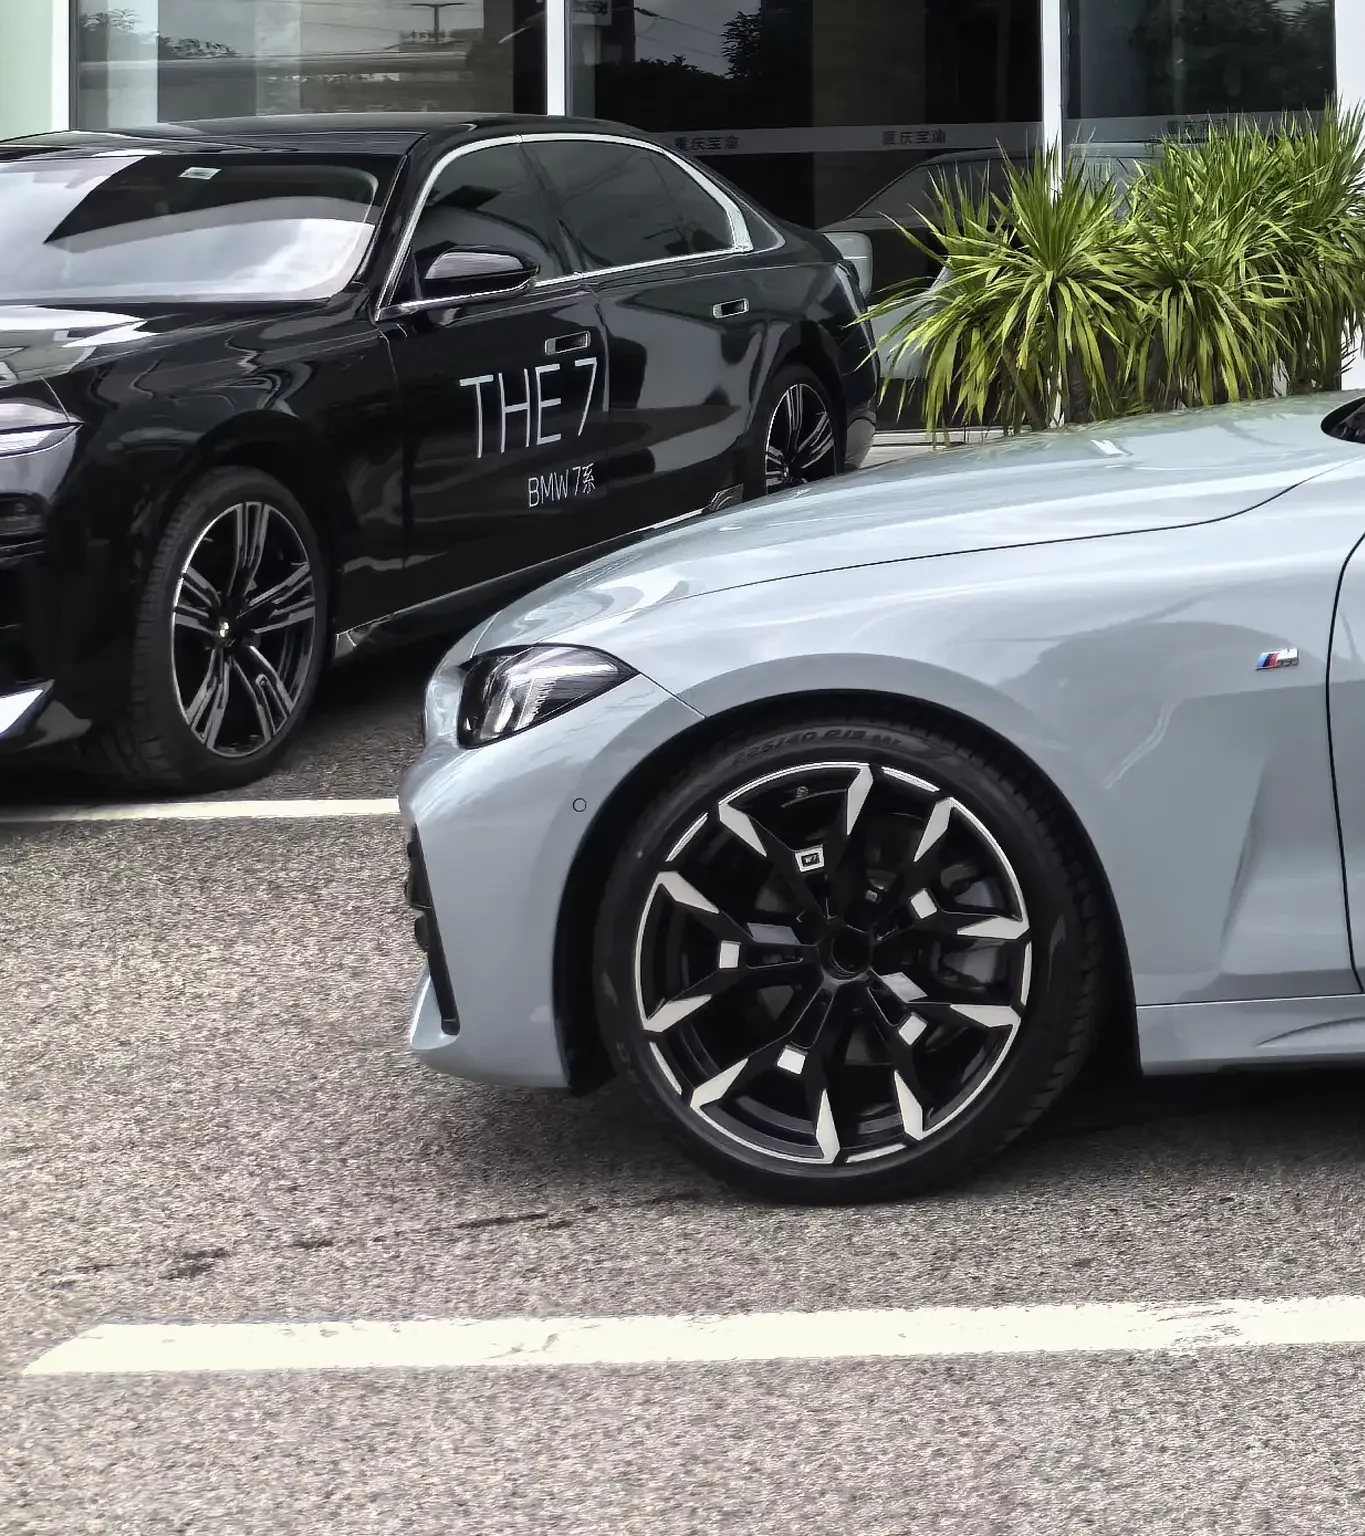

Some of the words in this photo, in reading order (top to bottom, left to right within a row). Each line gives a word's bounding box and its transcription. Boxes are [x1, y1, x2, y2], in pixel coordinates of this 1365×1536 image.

[459, 363, 562, 459] THE
[574, 357, 598, 437] 7
[528, 468, 570, 508] BMW
[572, 463, 596, 497] 7系
